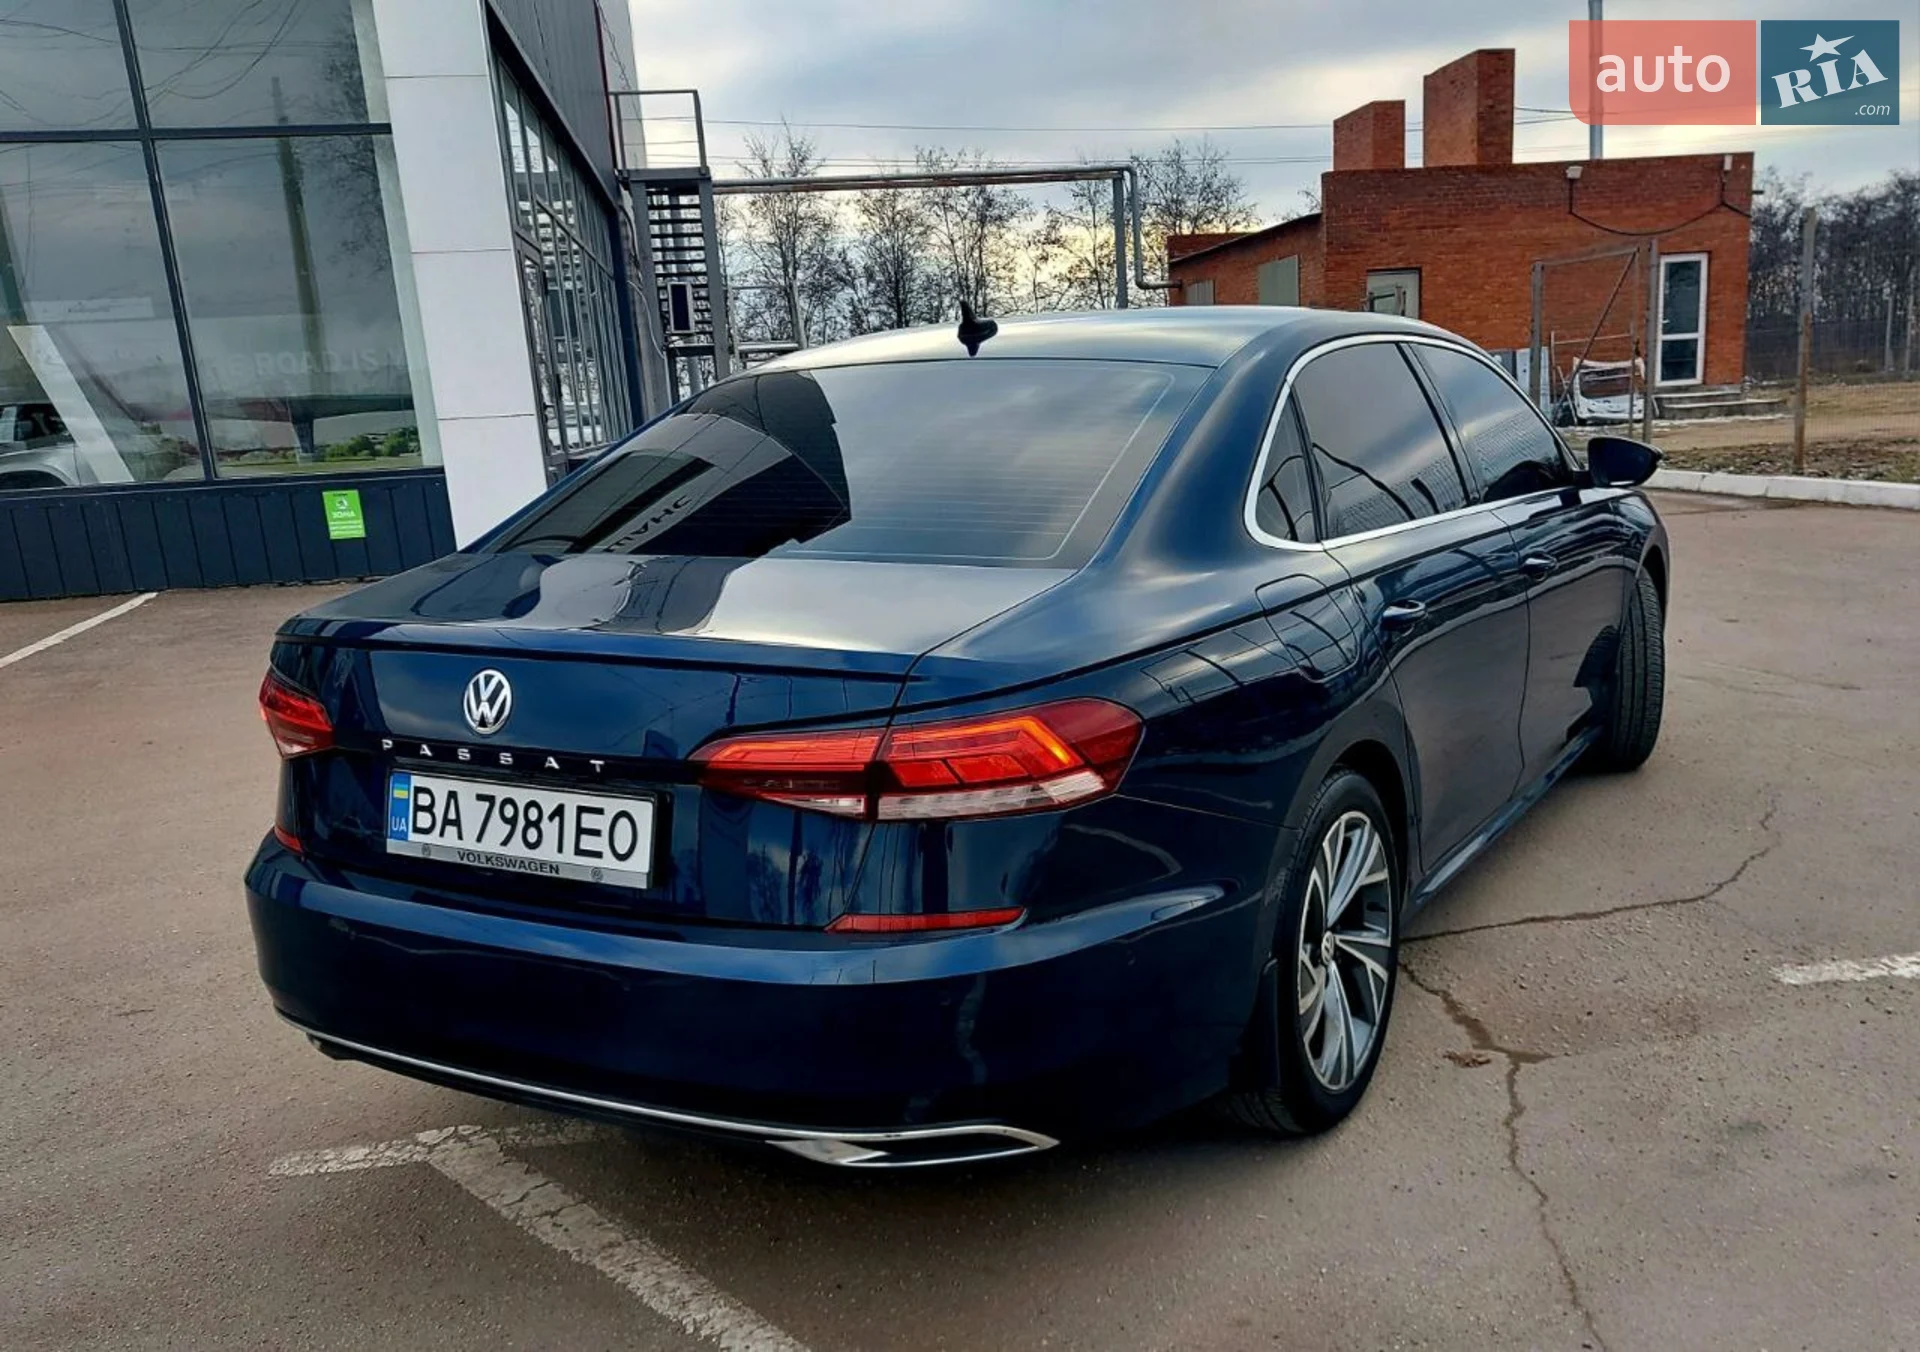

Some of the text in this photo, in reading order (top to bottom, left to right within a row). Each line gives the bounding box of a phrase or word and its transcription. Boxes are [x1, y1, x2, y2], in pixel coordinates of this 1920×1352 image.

[381, 738, 605, 773] PASSAT
[391, 815, 408, 832] UA
[456, 849, 560, 876] VOLKSWAGEN
